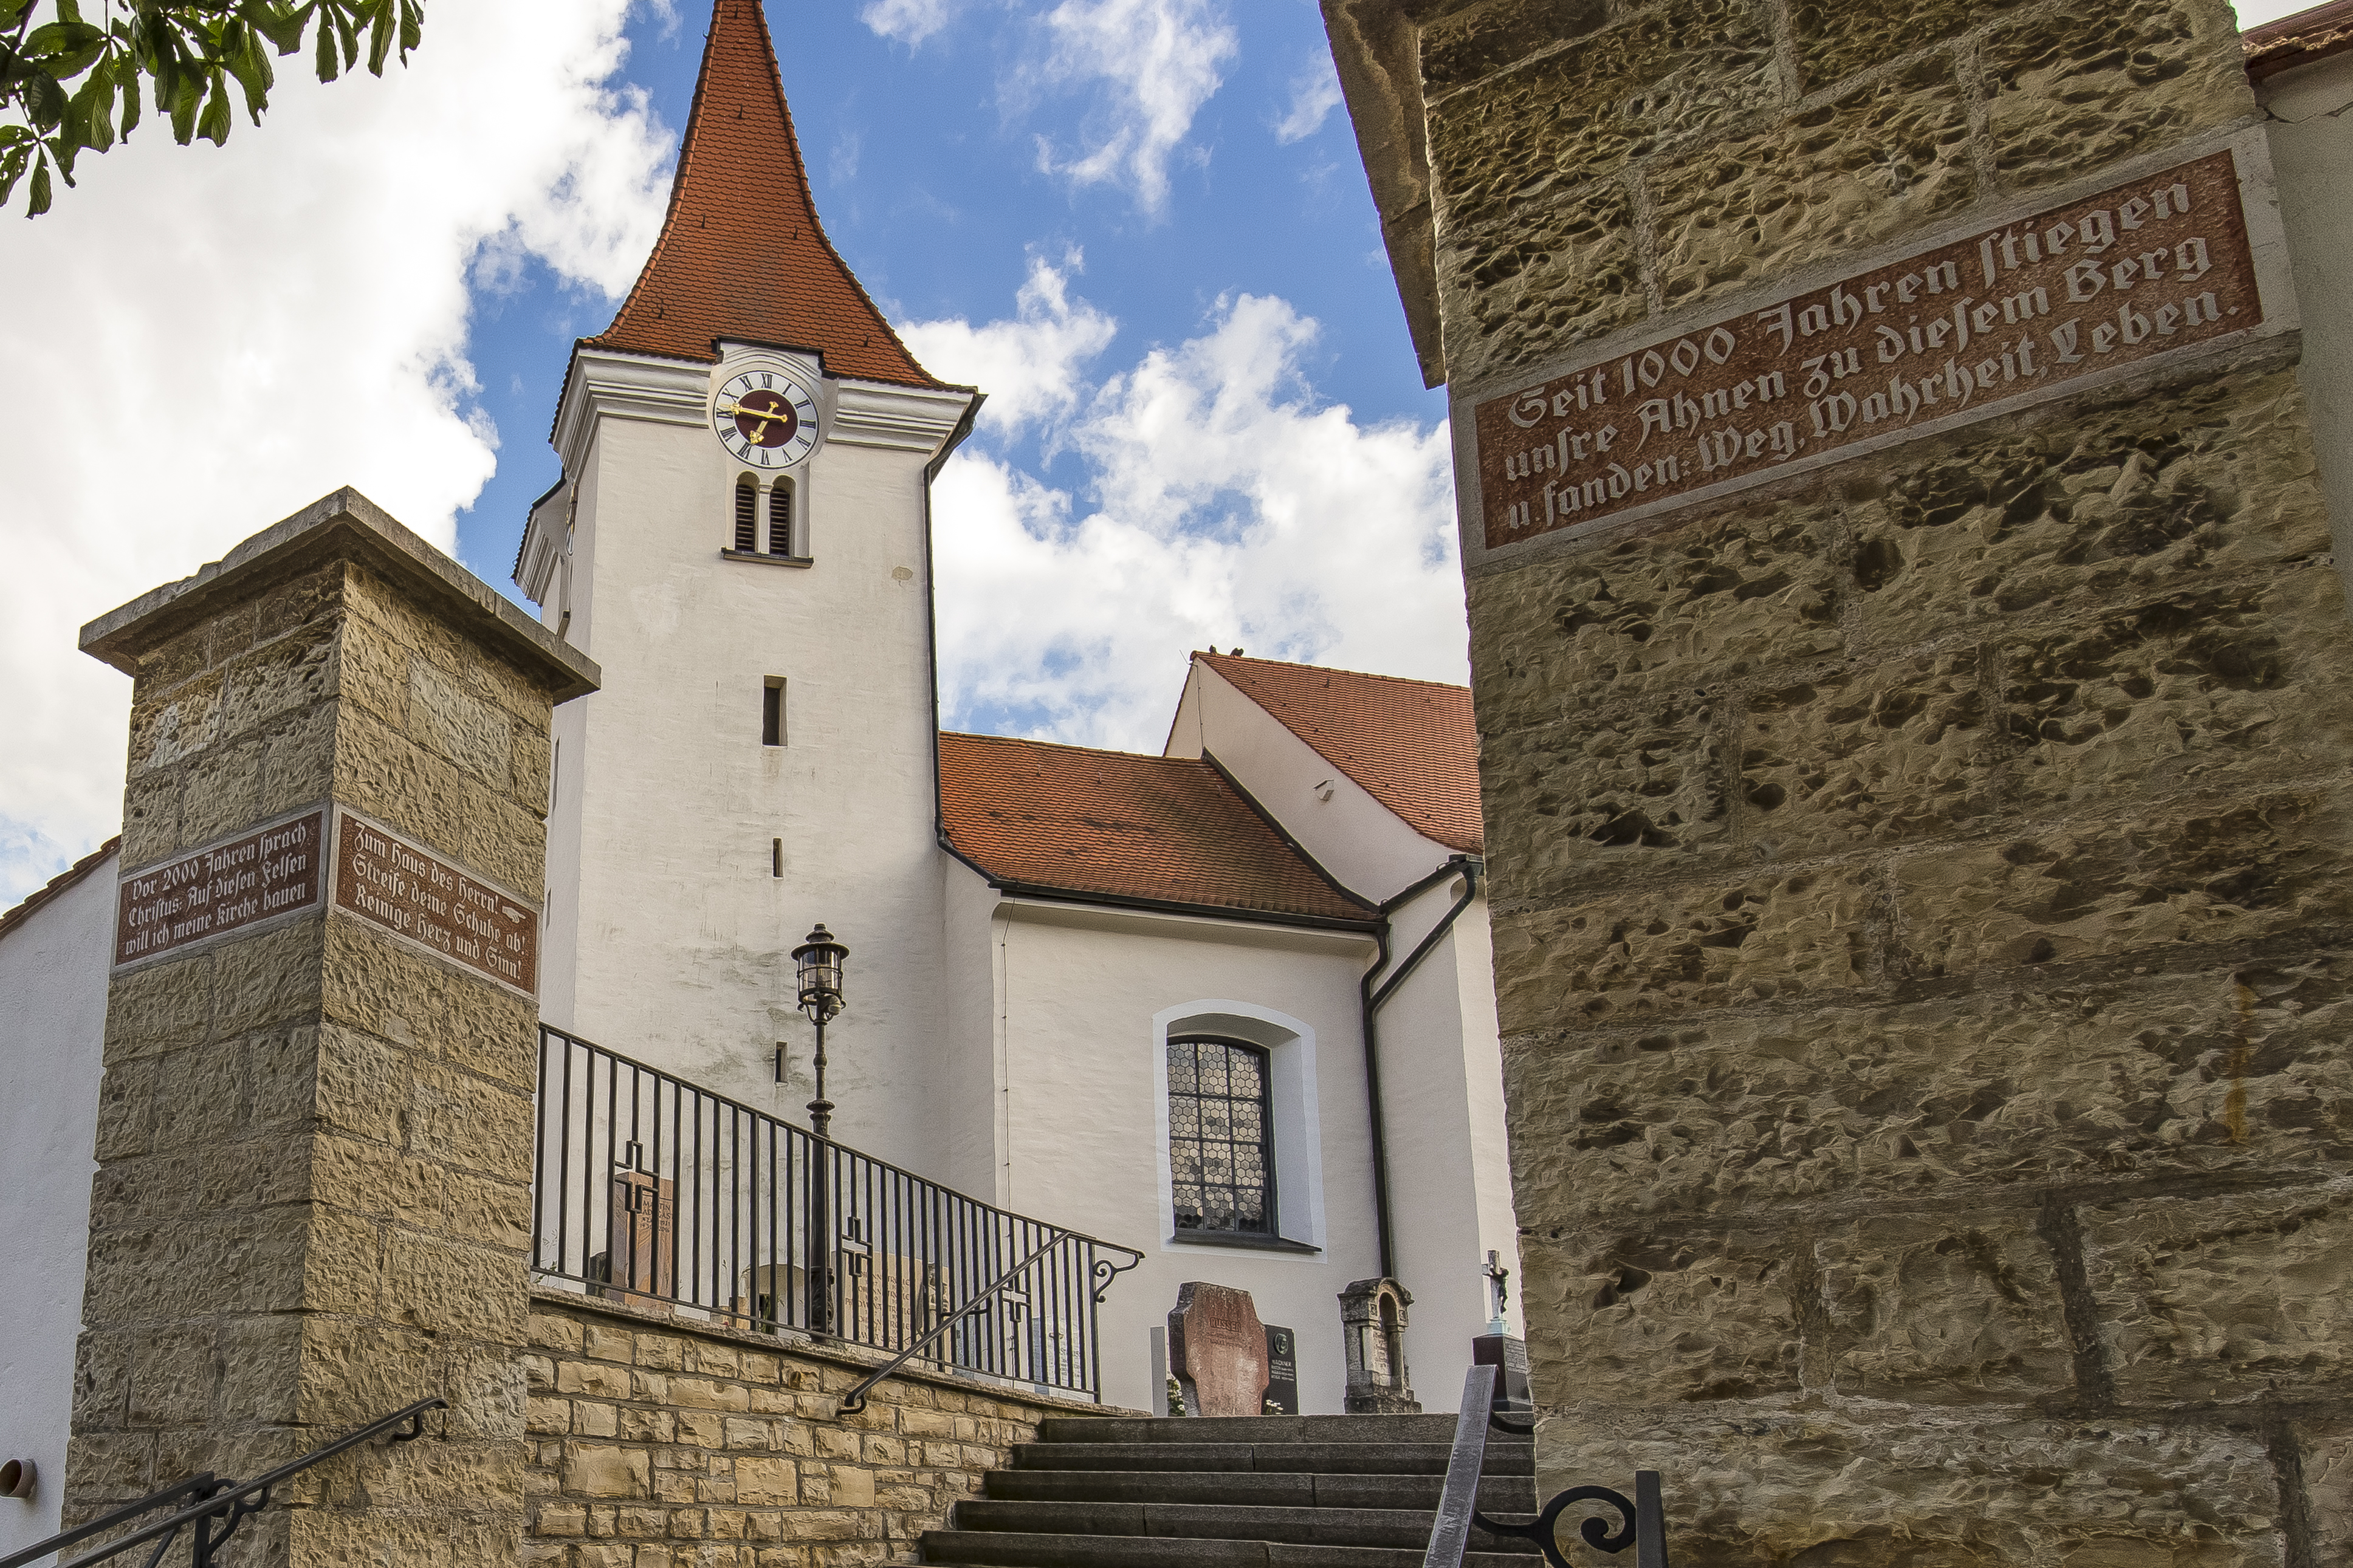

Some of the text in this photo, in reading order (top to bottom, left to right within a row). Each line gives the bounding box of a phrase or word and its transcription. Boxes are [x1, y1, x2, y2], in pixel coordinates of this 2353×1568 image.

[1508, 368, 1607, 428] Seit
[1622, 326, 1736, 398] 1000
[1757, 259, 1959, 357] Jahren
[1634, 369, 1787, 453] Ahnen
[2063, 236, 2213, 304] Berg
[738, 375, 754, 392] XI
[761, 373, 773, 389] XII
[783, 383, 792, 395] I
[723, 388, 740, 403] X
[795, 399, 811, 409] II
[716, 407, 733, 419] IX
[1544, 454, 1692, 527] fanden:
[1698, 422, 1807, 473] Weg,
[1809, 332, 2050, 439] Wahrheit,
[2049, 290, 2241, 365] Leben.
[799, 419, 816, 430] III
[721, 426, 737, 442] VIII
[795, 434, 811, 450] IV
[737, 442, 752, 459] VII
[760, 449, 770, 465] VI
[781, 448, 792, 463] V
[132, 877, 158, 901] Vor
[162, 858, 199, 891] 2000
[205, 843, 255, 880] Jahren
[354, 821, 499, 916] Zum Haus des Herrn!
[186, 880, 213, 912] Auf
[352, 852, 526, 956] Streife deine Schuhe ab!
[125, 882, 306, 956] will ich meine Kirche bauen
[354, 882, 522, 981] Reinige Herz und Sinn!
